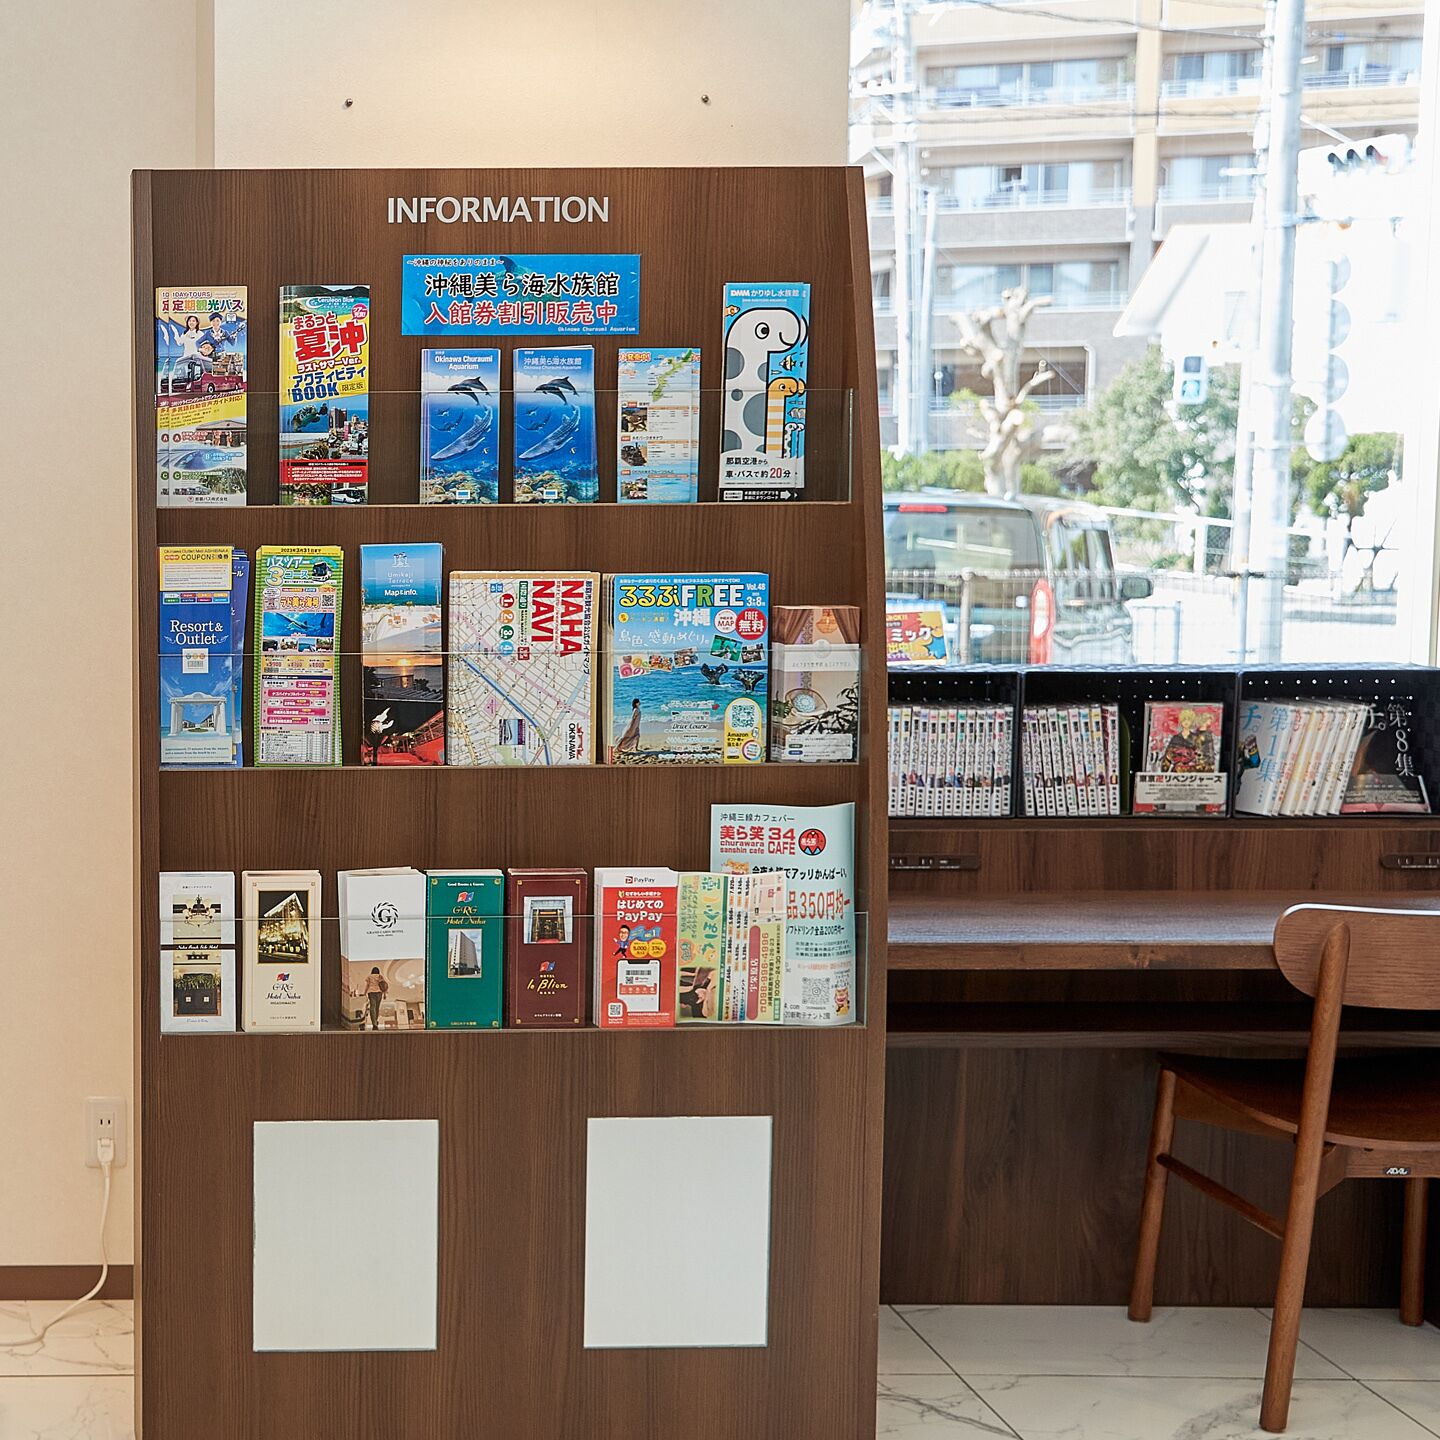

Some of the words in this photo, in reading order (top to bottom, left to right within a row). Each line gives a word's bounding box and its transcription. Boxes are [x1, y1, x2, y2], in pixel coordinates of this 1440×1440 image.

[387, 197, 609, 224] INFORMATION
[424, 273, 620, 298] 沖縄美ら海水族館
[172, 299, 244, 313] 定期観光バス
[293, 311, 336, 330] まるっと
[424, 301, 618, 326] 入館券割引販売中
[293, 321, 365, 362] 夏沖
[434, 355, 461, 363] Okinawa
[462, 355, 493, 363] Churaumi
[448, 363, 479, 371] Aquarium
[292, 366, 366, 388] アクティビティ
[292, 382, 340, 403] BOOK
[726, 457, 769, 465] 那覇空港から
[725, 467, 791, 479] 車・バスで約20分
[531, 580, 556, 643] NAVI
[673, 607, 710, 627] 沖縄
[744, 611, 758, 620] FREE
[560, 580, 585, 658] NAHA
[170, 620, 224, 634] Resort&
[738, 621, 765, 632] 無料
[175, 632, 217, 645] Outlet
[568, 722, 576, 760] OKINAWA
[1386, 703, 1415, 777] 第8集
[720, 813, 795, 822] 沖縄三線カフェバー
[720, 825, 764, 840] 美ら笑
[768, 827, 796, 841] 34
[768, 841, 796, 855] CAFE
[616, 899, 664, 910] はじめての
[378, 908, 391, 923] G
[444, 917, 464, 925] Hotel
[616, 911, 663, 923] PayPay
